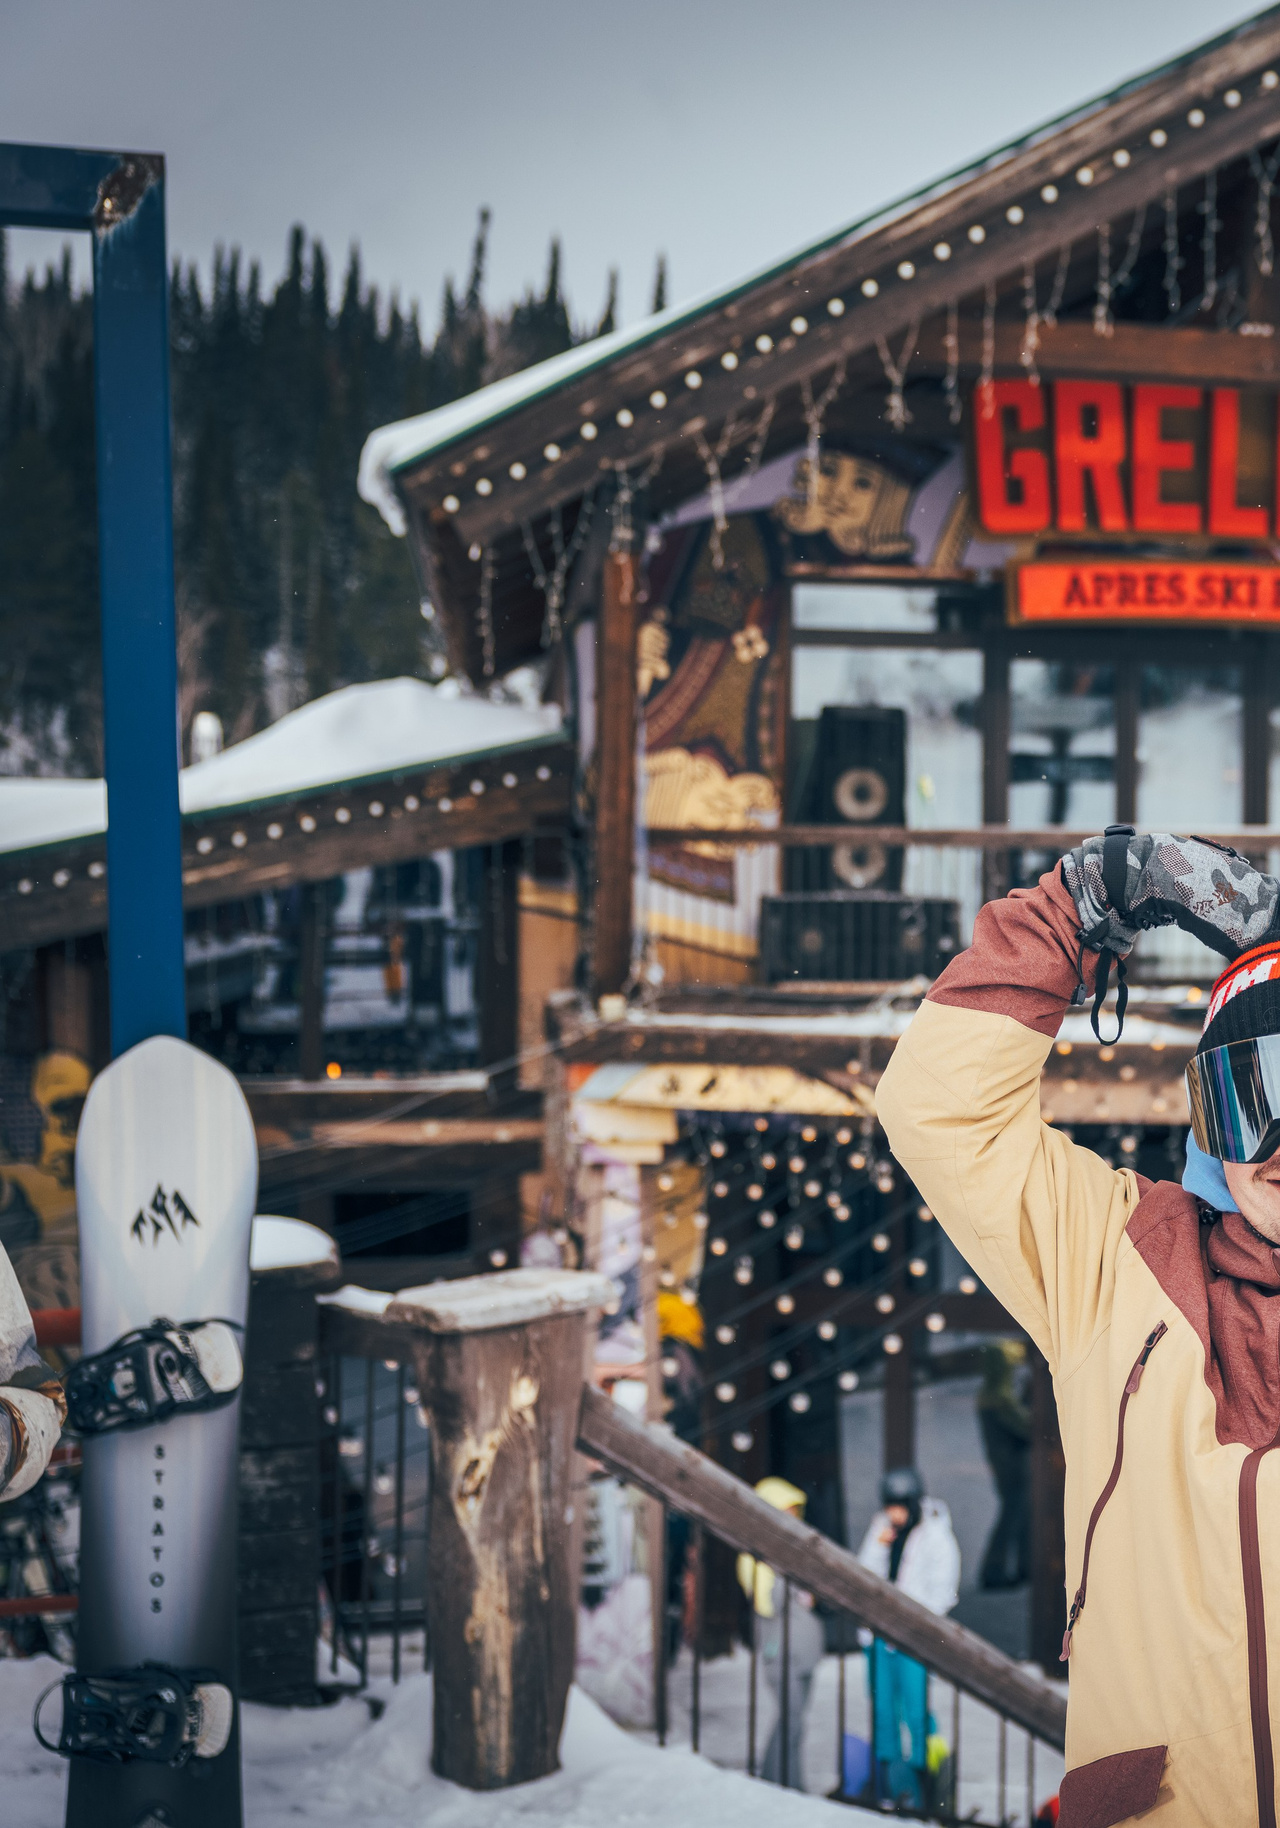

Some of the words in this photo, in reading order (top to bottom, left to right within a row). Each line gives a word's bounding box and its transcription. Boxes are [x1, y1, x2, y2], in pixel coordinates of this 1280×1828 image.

[1064, 571, 1186, 608] APRES
[1196, 573, 1259, 610] SKI
[150, 1444, 165, 1614] STRATOS
